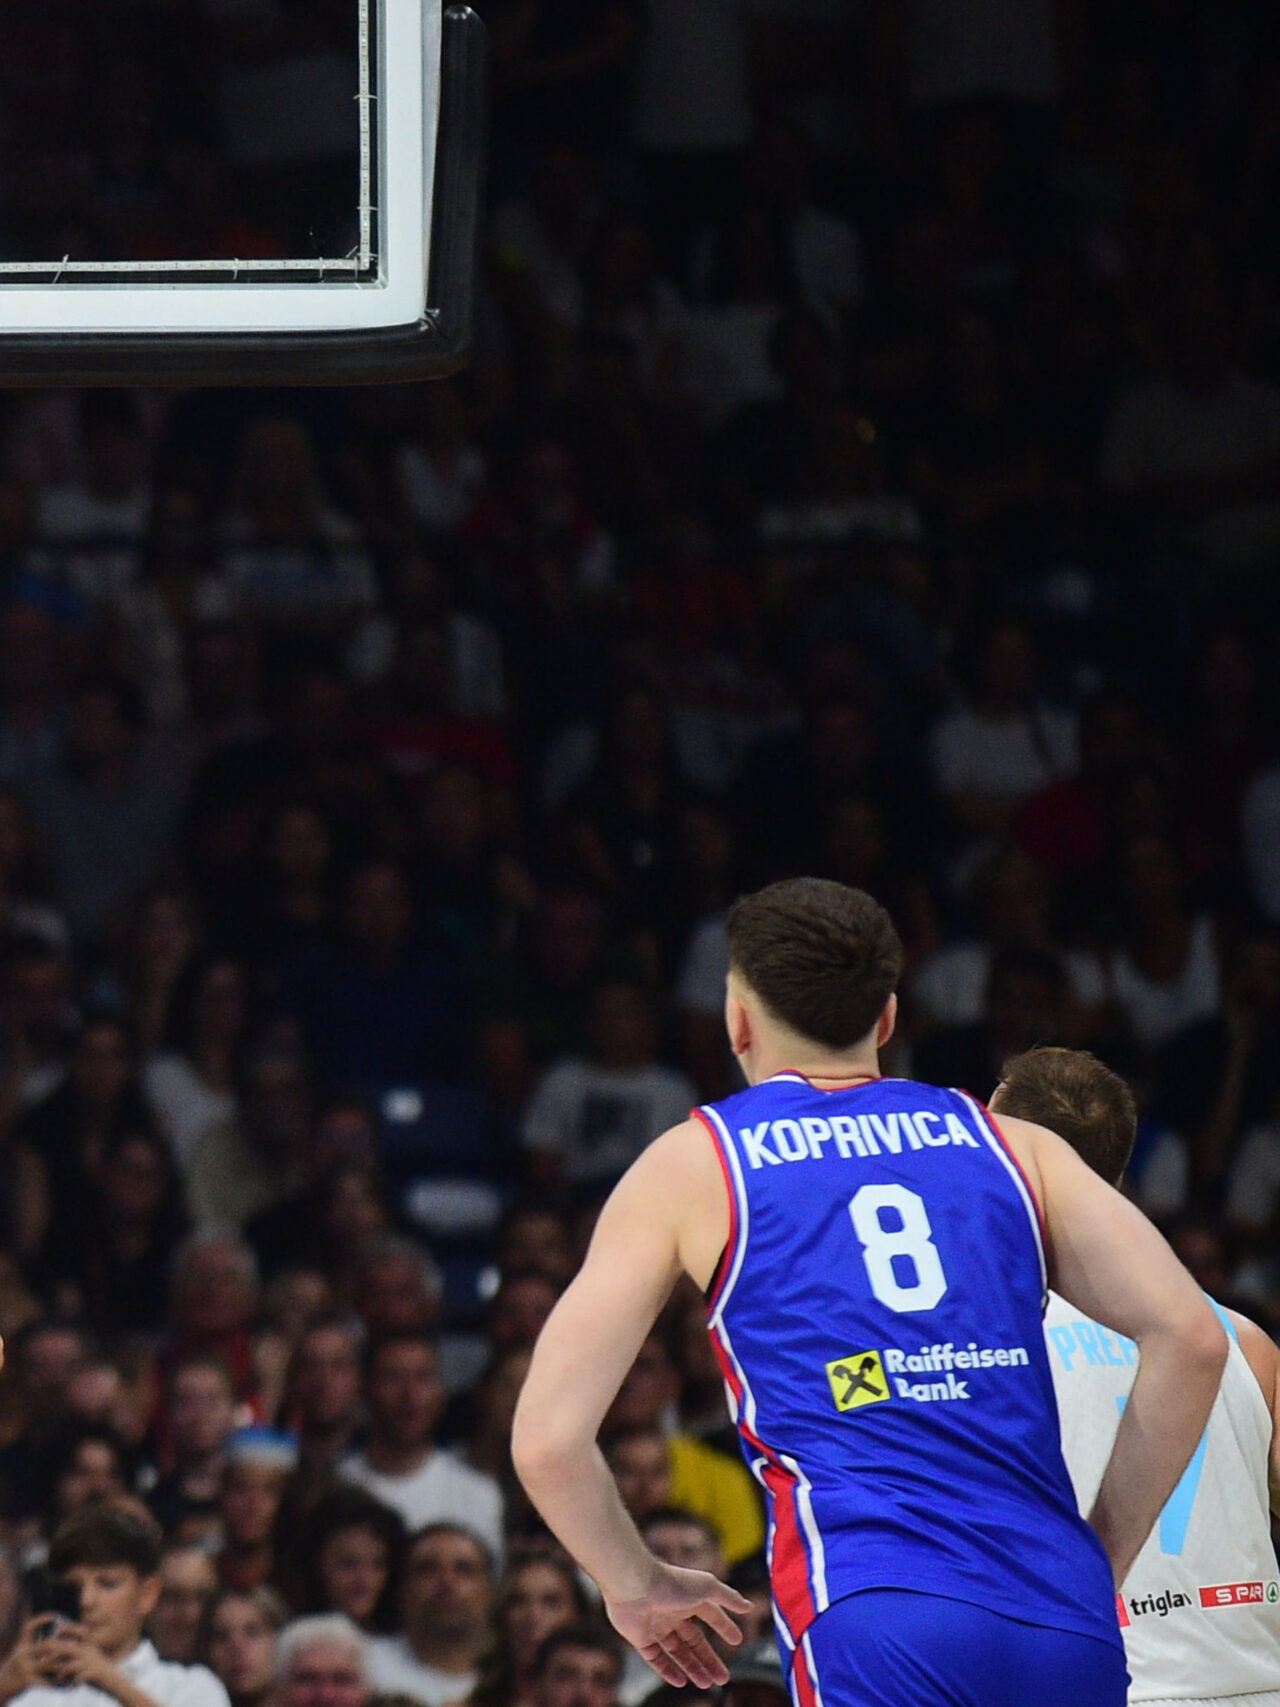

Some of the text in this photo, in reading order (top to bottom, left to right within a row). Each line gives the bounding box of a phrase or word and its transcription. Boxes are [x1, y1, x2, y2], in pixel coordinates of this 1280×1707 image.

[739, 1110, 981, 1170] KOPRIVICA
[848, 1183, 948, 1313] 8
[884, 1342, 1029, 1373] Raiffeisen
